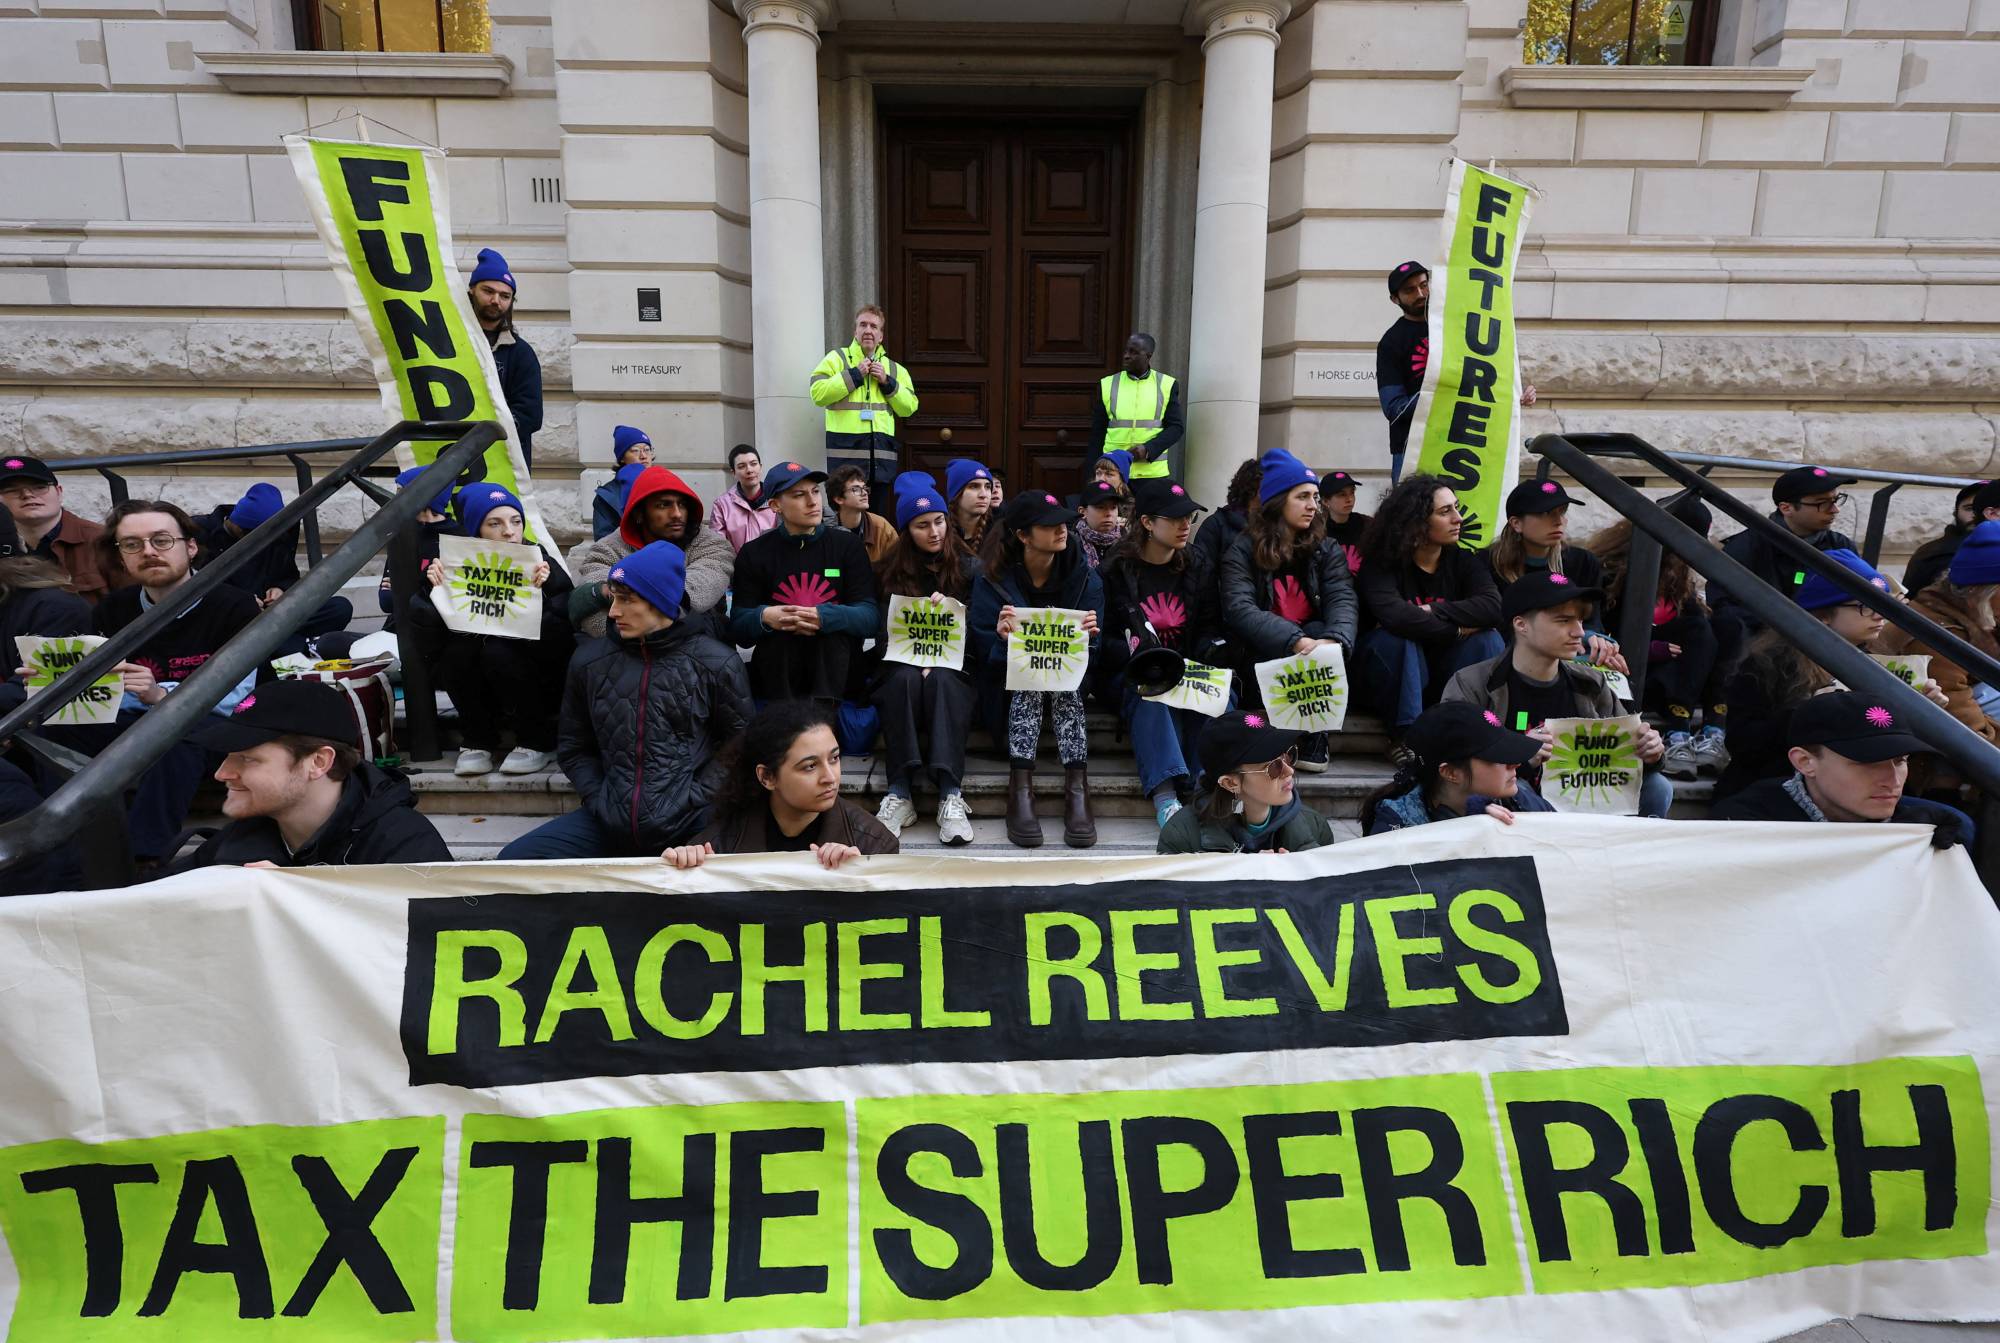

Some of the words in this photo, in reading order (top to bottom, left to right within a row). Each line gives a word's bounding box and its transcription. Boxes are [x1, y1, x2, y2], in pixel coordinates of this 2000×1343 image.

[339, 157, 476, 422] FUND
[1438, 183, 1512, 492] FUTURES
[611, 365, 628, 375] HM
[631, 365, 682, 375] TREASURY
[1309, 370, 1314, 380] 1
[1317, 370, 1351, 380] HORSE
[1353, 370, 1378, 380] GUA
[462, 566, 491, 582] TAX
[495, 569, 524, 587] THE
[465, 582, 516, 603] SUPER
[470, 600, 506, 618] RICH
[902, 610, 927, 626] TAX
[929, 613, 955, 627] THE
[908, 627, 949, 643] SUPER
[1020, 622, 1048, 638] TAX
[1049, 623, 1076, 639] THE
[913, 642, 943, 657] RICH
[1024, 640, 1070, 655] SUPER
[1030, 655, 1062, 671] RICH
[1277, 671, 1306, 689] TAX
[1306, 666, 1336, 682] THE
[1286, 683, 1334, 704] SUPER
[1297, 699, 1331, 718] RICH
[1574, 735, 1620, 751] FUND
[1578, 753, 1611, 769] OUR
[1560, 771, 1631, 789] FUTURES
[428, 916, 991, 1055] RACHEL
[1025, 889, 1541, 1025] REEVES
[20, 1146, 419, 1320] TAX
[470, 1127, 828, 1312] THE
[873, 1106, 1486, 1300] SUPER
[1506, 1084, 1958, 1262] RICH
